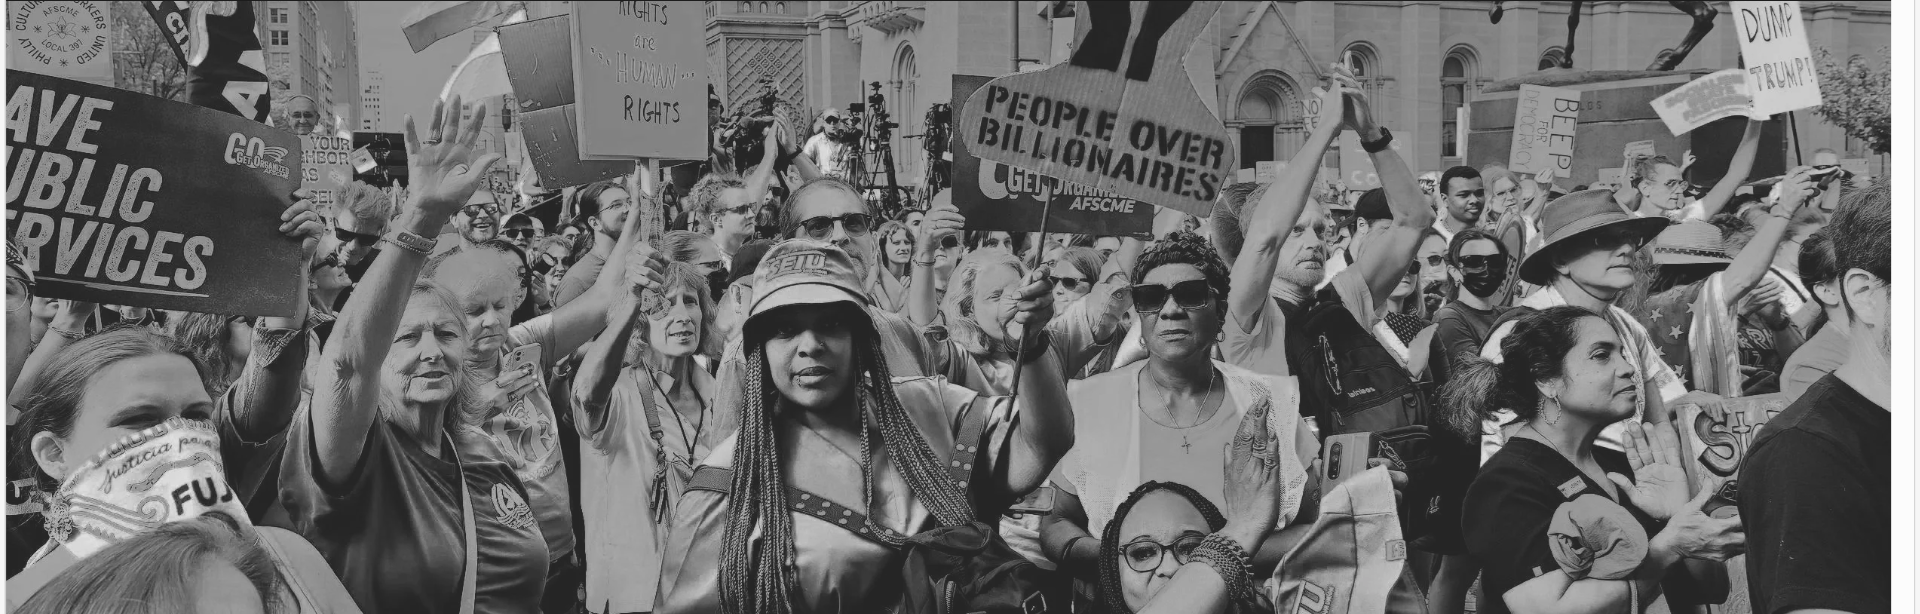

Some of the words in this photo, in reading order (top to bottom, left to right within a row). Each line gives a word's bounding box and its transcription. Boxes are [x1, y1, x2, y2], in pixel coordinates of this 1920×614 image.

[42, 5, 80, 18] AFSCME
[1741, 2, 1793, 43] DUMP
[18, 37, 52, 65] PHILLY
[76, 35, 107, 65] UNITED
[41, 38, 68, 53] LOCAL
[634, 35, 656, 51] are
[616, 51, 677, 90] HUMAN
[1749, 57, 1813, 91] TRUMP!
[624, 94, 680, 125] RIGHTS
[985, 85, 1118, 141] PEOPLE
[1129, 117, 1225, 170] OVER
[1514, 89, 1540, 170] DEMOCRACY
[1536, 120, 1549, 143] FOR
[1548, 98, 1579, 170] BEEP
[310, 136, 350, 151] YOUR
[977, 116, 1219, 202] BILLIONAIRES
[1069, 197, 1136, 214] AFSCME
[6, 208, 215, 290] RVICES
[766, 254, 827, 278] SEIU
